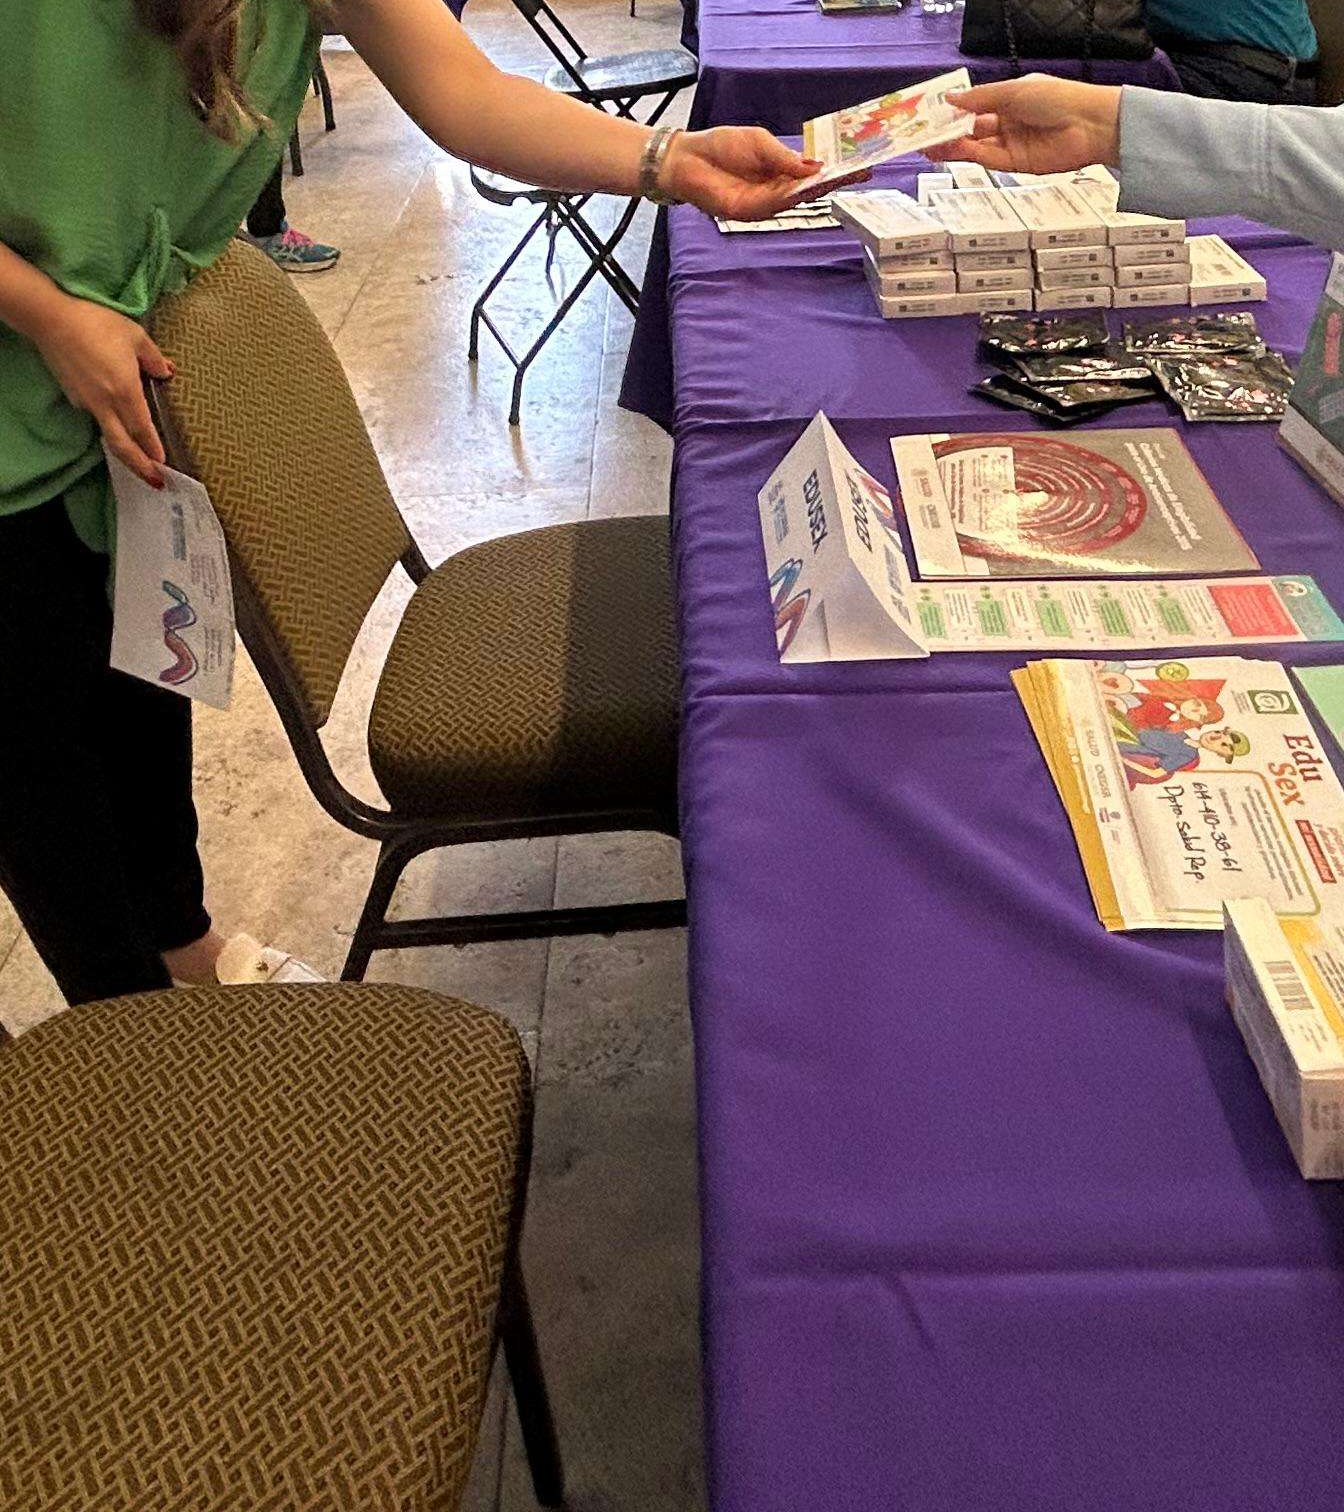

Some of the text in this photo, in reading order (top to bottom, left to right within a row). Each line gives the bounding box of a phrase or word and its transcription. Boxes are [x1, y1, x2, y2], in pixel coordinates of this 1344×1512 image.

[803, 469, 827, 554] EDUSEX
[1283, 734, 1323, 782] Edu
[1268, 762, 1305, 806] Sex
